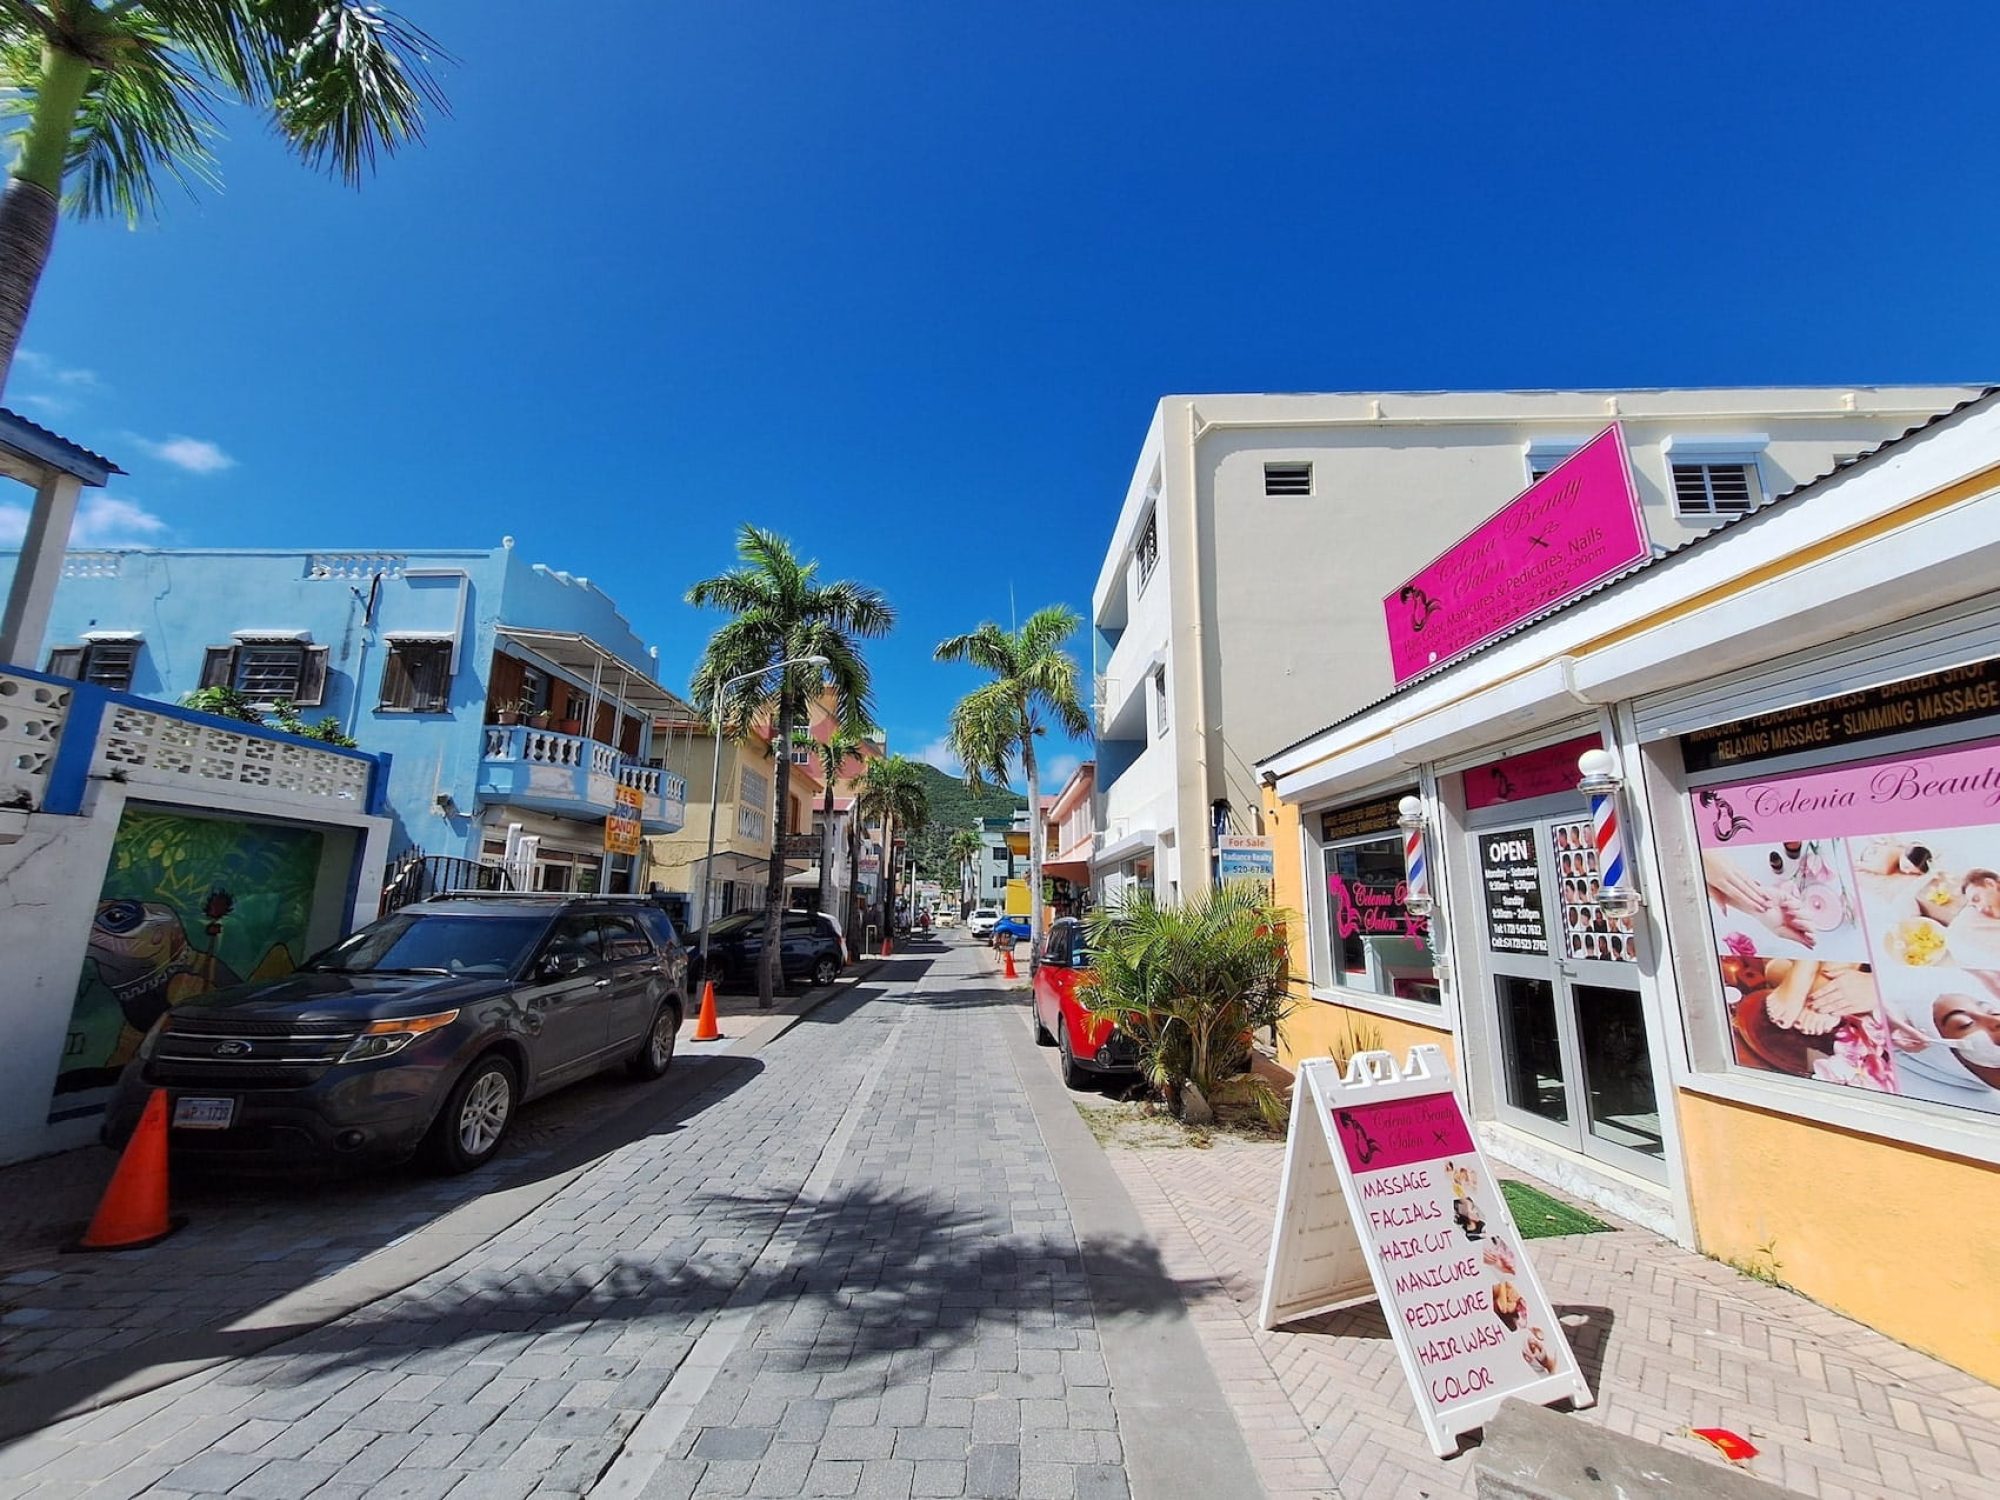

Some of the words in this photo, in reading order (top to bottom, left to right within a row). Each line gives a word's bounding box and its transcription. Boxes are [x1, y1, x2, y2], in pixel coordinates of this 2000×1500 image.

[1504, 477, 1582, 539] Beauty
[1447, 594, 1495, 627] Manicures
[1496, 585, 1504, 597] &
[1568, 527, 1603, 555] Nails
[1453, 558, 1505, 598] Salon
[1717, 731, 1768, 761] RELAXING
[1771, 717, 1830, 750] MASSAGE
[1844, 699, 1914, 736] SLIMMING
[1918, 680, 1999, 721] MASSAGE
[1746, 786, 1857, 817] Celenia
[608, 817, 638, 834] CANDY
[1229, 839, 1243, 847] For
[1246, 839, 1265, 847] Sale
[1490, 840, 1528, 862] OPEN
[1511, 866, 1537, 879] Saturday
[1353, 882, 1393, 907] Celenia
[1502, 894, 1525, 908] Sunday
[1364, 906, 1398, 934] Salon
[1416, 1102, 1455, 1127] Beauty
[1388, 1131, 1423, 1150] Salon
[1363, 1171, 1431, 1200] MASSAGE
[1370, 1200, 1442, 1231] FACIALS
[1380, 1238, 1423, 1263] HAIR
[1424, 1229, 1453, 1253] CUT
[1396, 1257, 1480, 1296] MANICURE
[1405, 1290, 1489, 1330] PEDICURE
[1417, 1337, 1462, 1367] HAIR
[1460, 1324, 1506, 1353] WASH
[1432, 1367, 1494, 1403] COLOR
